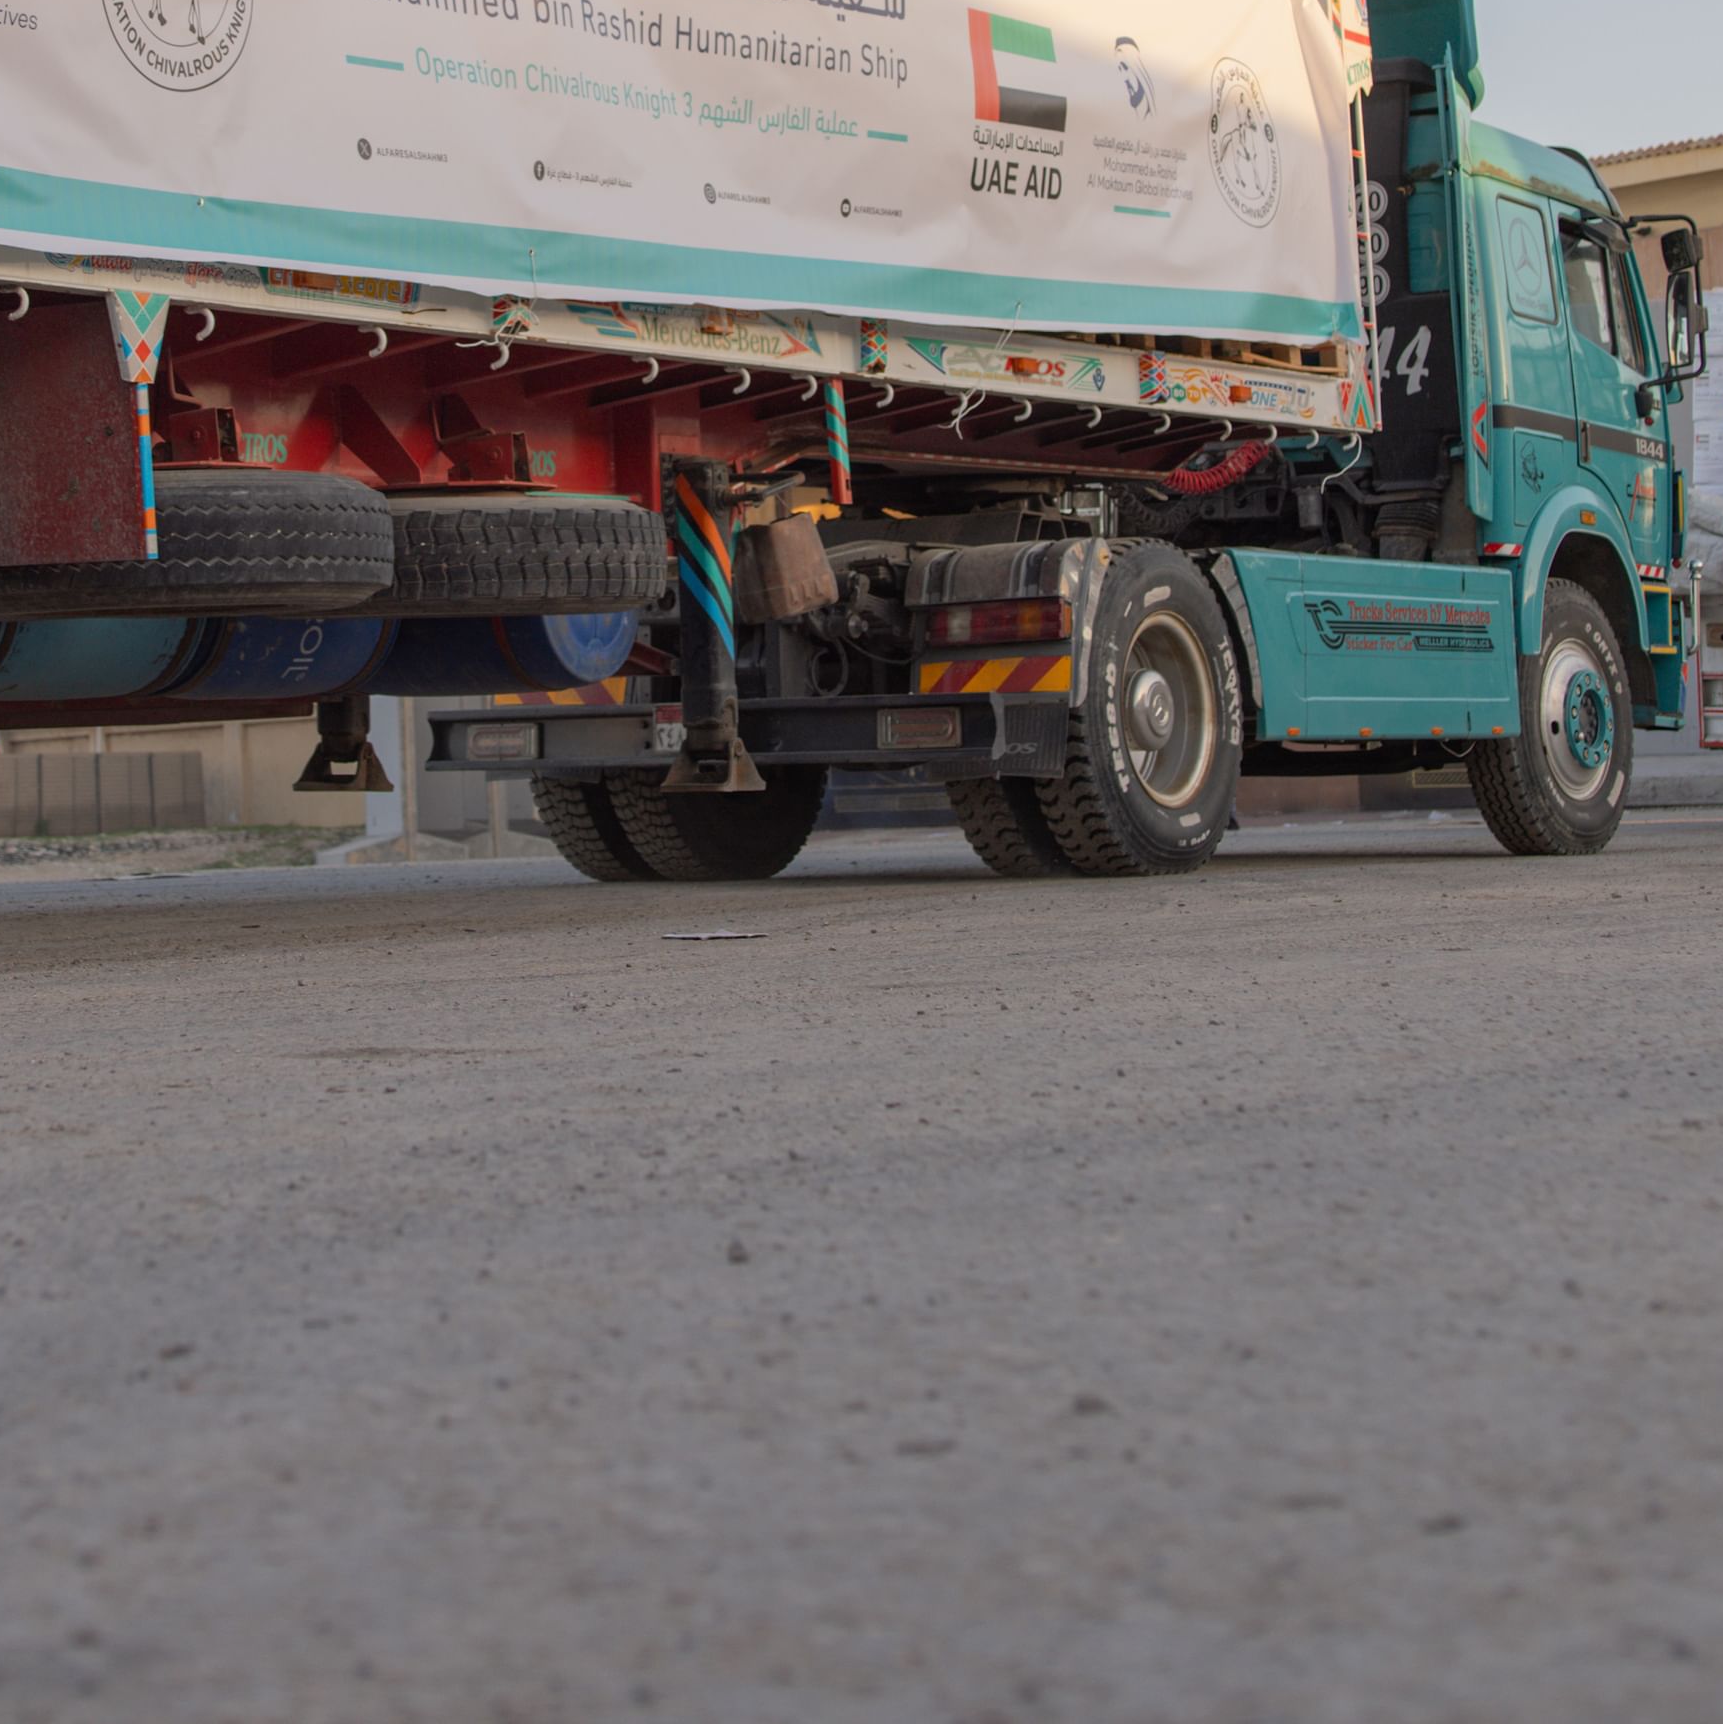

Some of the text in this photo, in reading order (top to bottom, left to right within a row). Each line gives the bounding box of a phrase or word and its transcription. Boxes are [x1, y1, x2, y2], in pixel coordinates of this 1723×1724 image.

[146, 37, 230, 78] CHIVALROUS
[675, 15, 851, 74] Humanitarian
[860, 43, 908, 88] Ship
[415, 46, 693, 120] Operation Chivalrous Knight 3
[698, 96, 859, 139] عملية الفارس الشهم
[973, 125, 1014, 154] الإماراتية
[1015, 134, 1064, 157] المساعدات
[376, 147, 448, 163] ALFARESALSHAHM3
[970, 156, 1062, 200] UAE AID
[1097, 174, 1134, 193] Maktoum
[1135, 179, 1159, 197] Global
[1250, 390, 1277, 407] ONE
[242, 432, 288, 464] TROS
[1635, 438, 1664, 459] 1844
[1347, 600, 1383, 621] Trucks
[1385, 603, 1428, 623] Services
[1445, 605, 1491, 625] Mercedes
[1380, 638, 1394, 651] For
[1395, 638, 1414, 651] Car
[1592, 631, 1617, 676] ONYX
